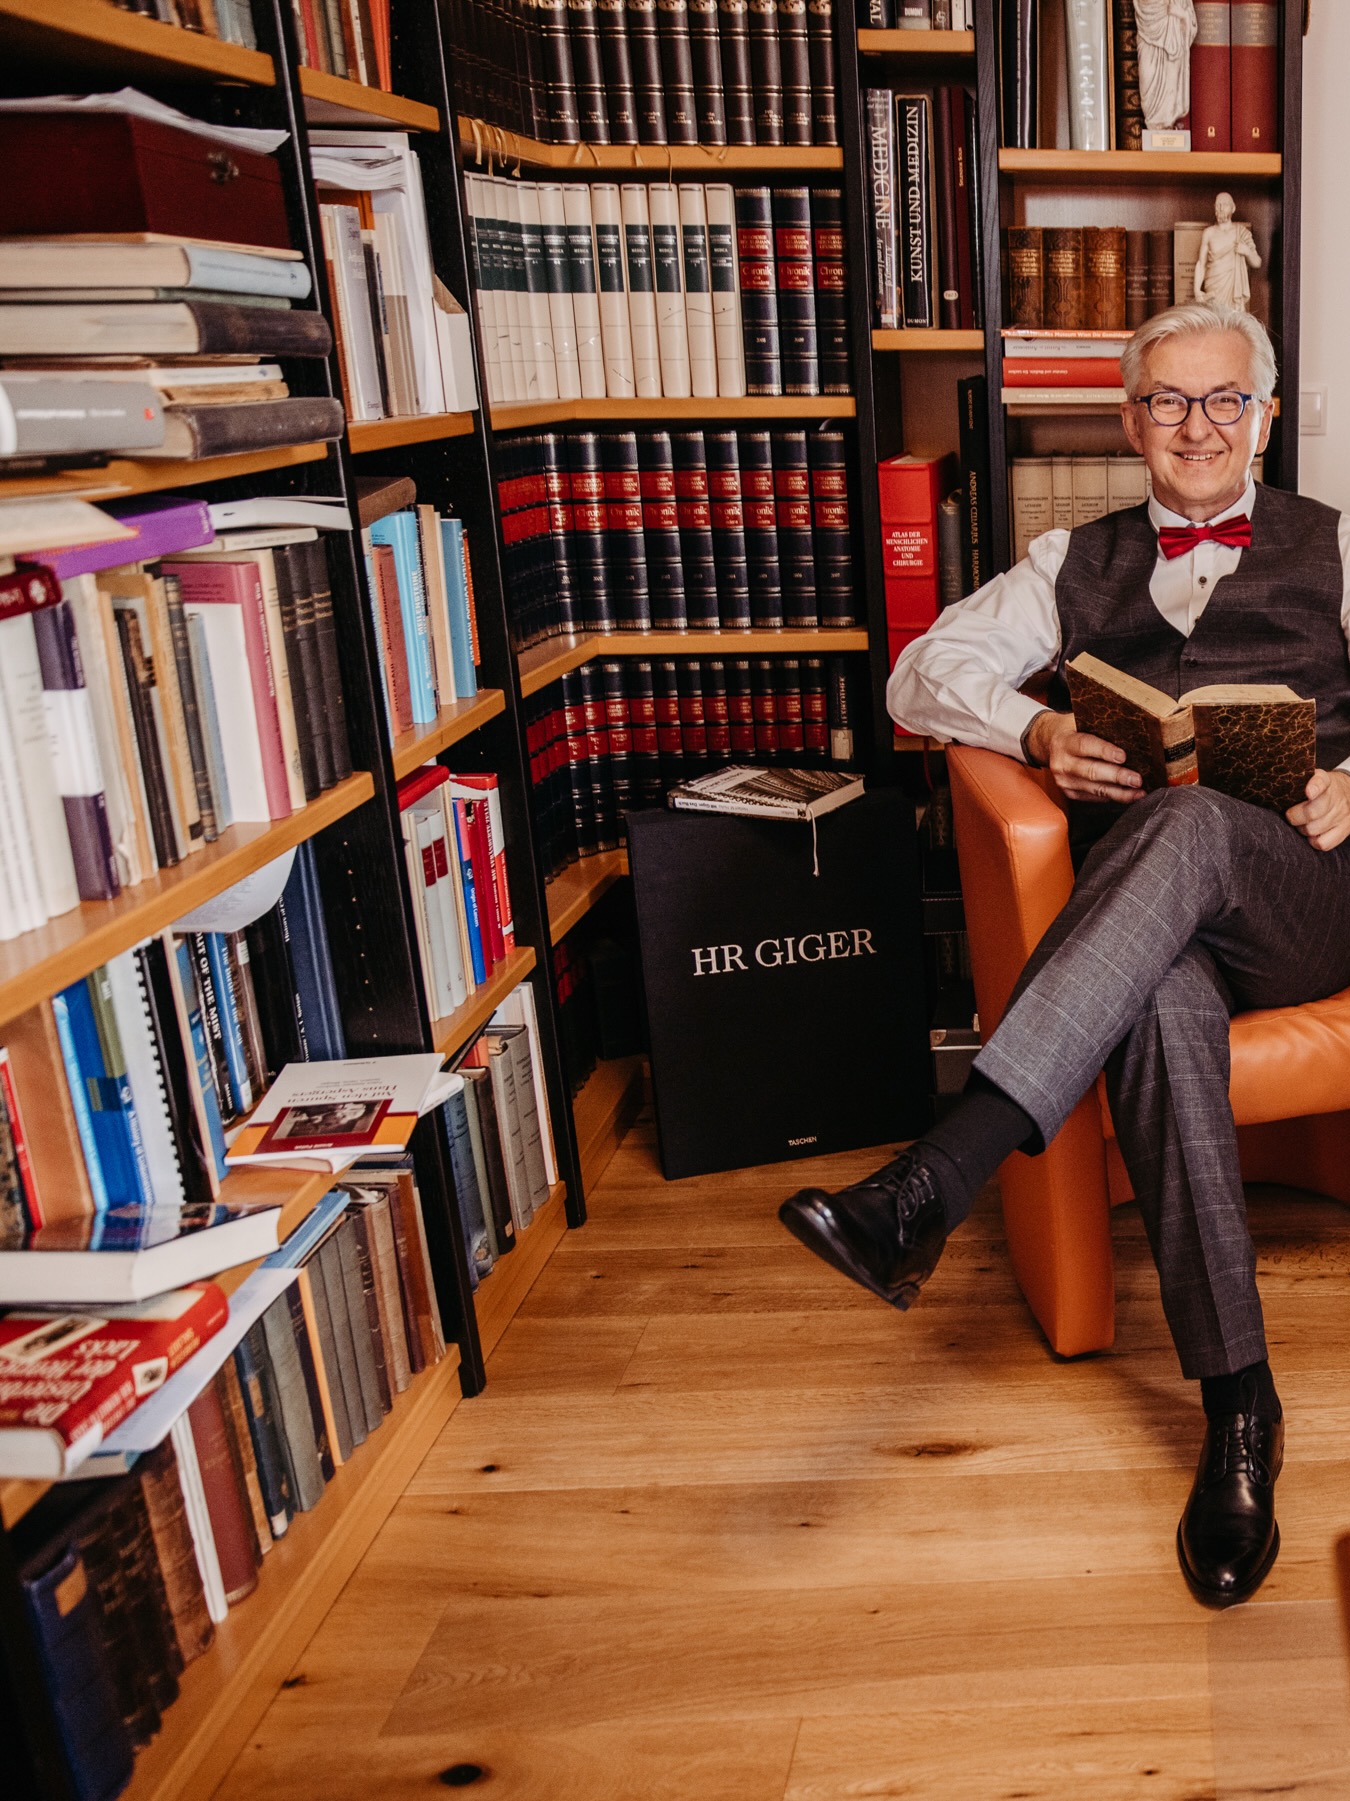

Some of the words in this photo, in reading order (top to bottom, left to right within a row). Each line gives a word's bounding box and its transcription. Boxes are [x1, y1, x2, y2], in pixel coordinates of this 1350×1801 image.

[904, 7, 923, 17] DUMONT
[905, 105, 920, 186] MEDIZIN
[872, 126, 890, 229] MEDICINE
[908, 187, 921, 223] UND
[909, 227, 923, 282] KUNST
[743, 265, 773, 276] Cronik
[781, 265, 811, 276] hronik
[969, 471, 978, 506] ANDREAS
[970, 507, 979, 544] CELLARIUS
[412, 571, 423, 635] MEILENSTEINE
[220, 945, 231, 965] The
[691, 944, 749, 976] HR
[755, 928, 877, 967] GIGER
[199, 958, 210, 976] OF
[202, 977, 216, 1005] THE
[207, 1007, 223, 1041] MIST
[223, 1084, 234, 1110] MALKIN
[288, 1095, 337, 1103] Spuren
[372, 1090, 392, 1098] Auf
[788, 1136, 817, 1146] TASCHEN
